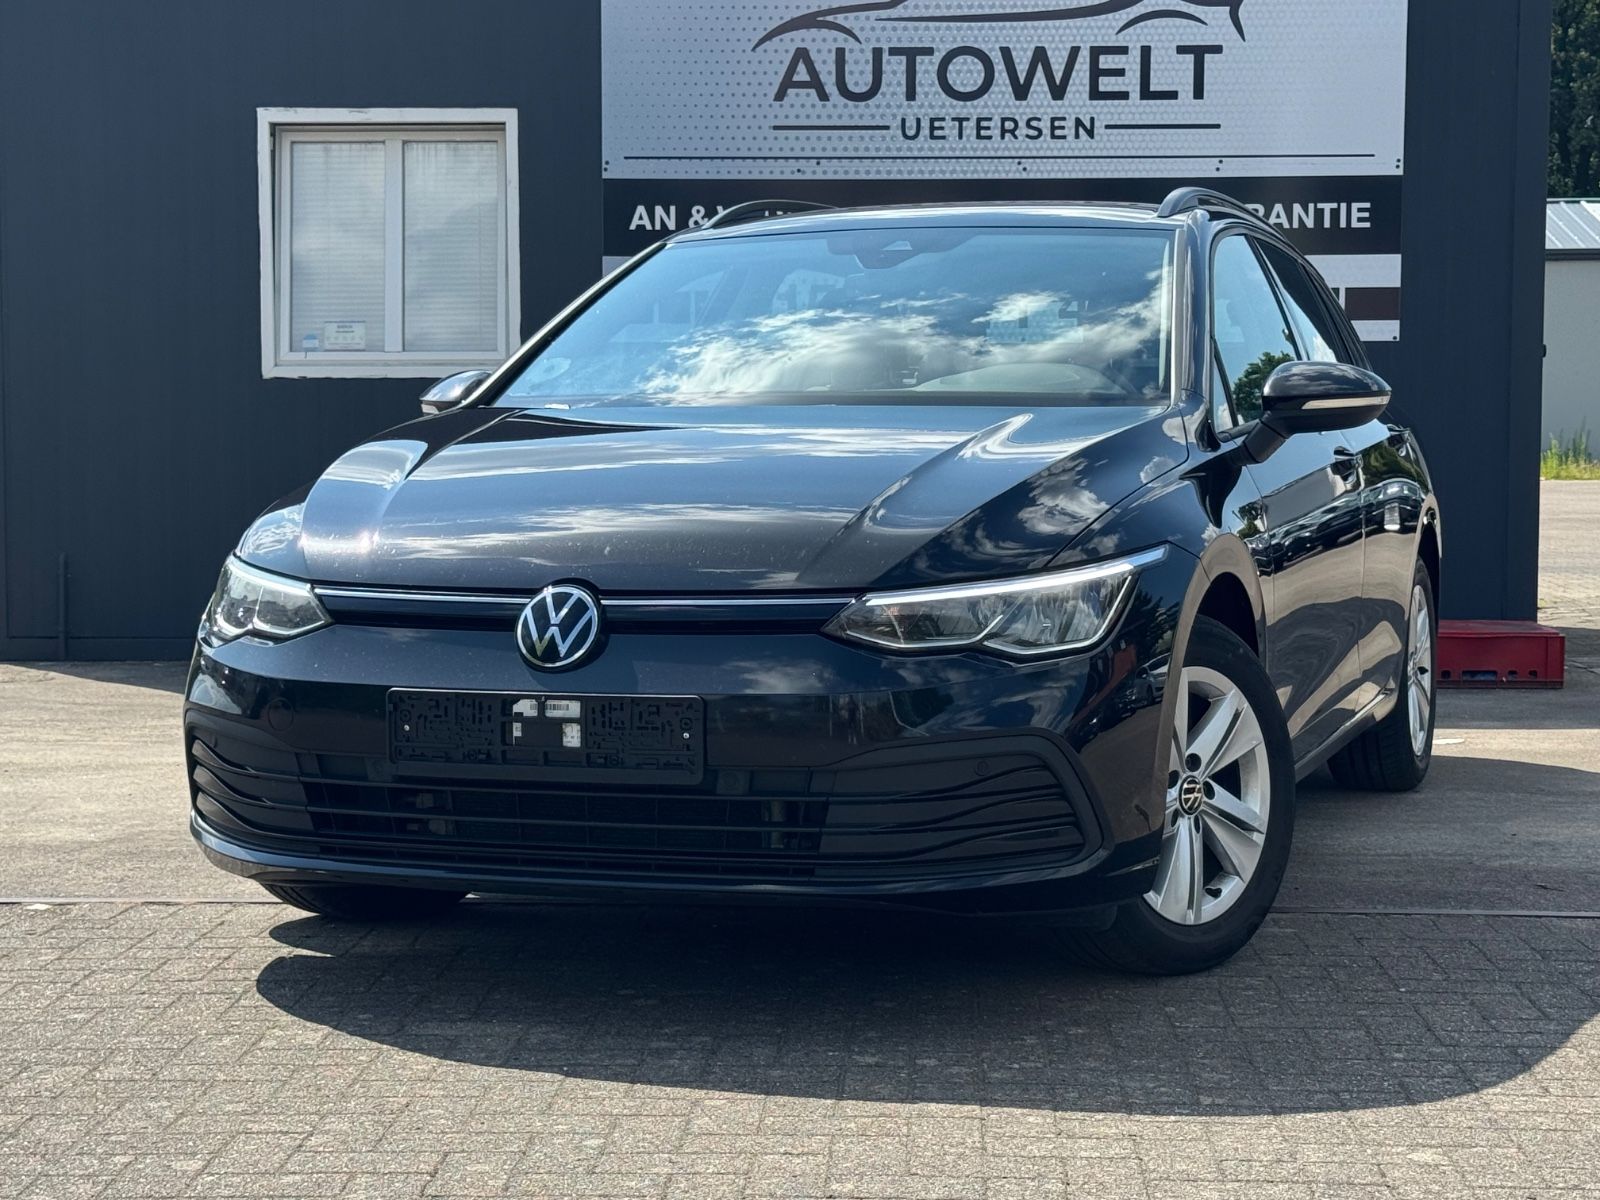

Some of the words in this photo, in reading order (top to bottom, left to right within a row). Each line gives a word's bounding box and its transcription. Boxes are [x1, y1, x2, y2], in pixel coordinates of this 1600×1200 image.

[773, 45, 1223, 101] AUTOWELT
[900, 117, 1096, 140] UETERSEN
[629, 205, 677, 230] AN
[688, 205, 709, 228] &
